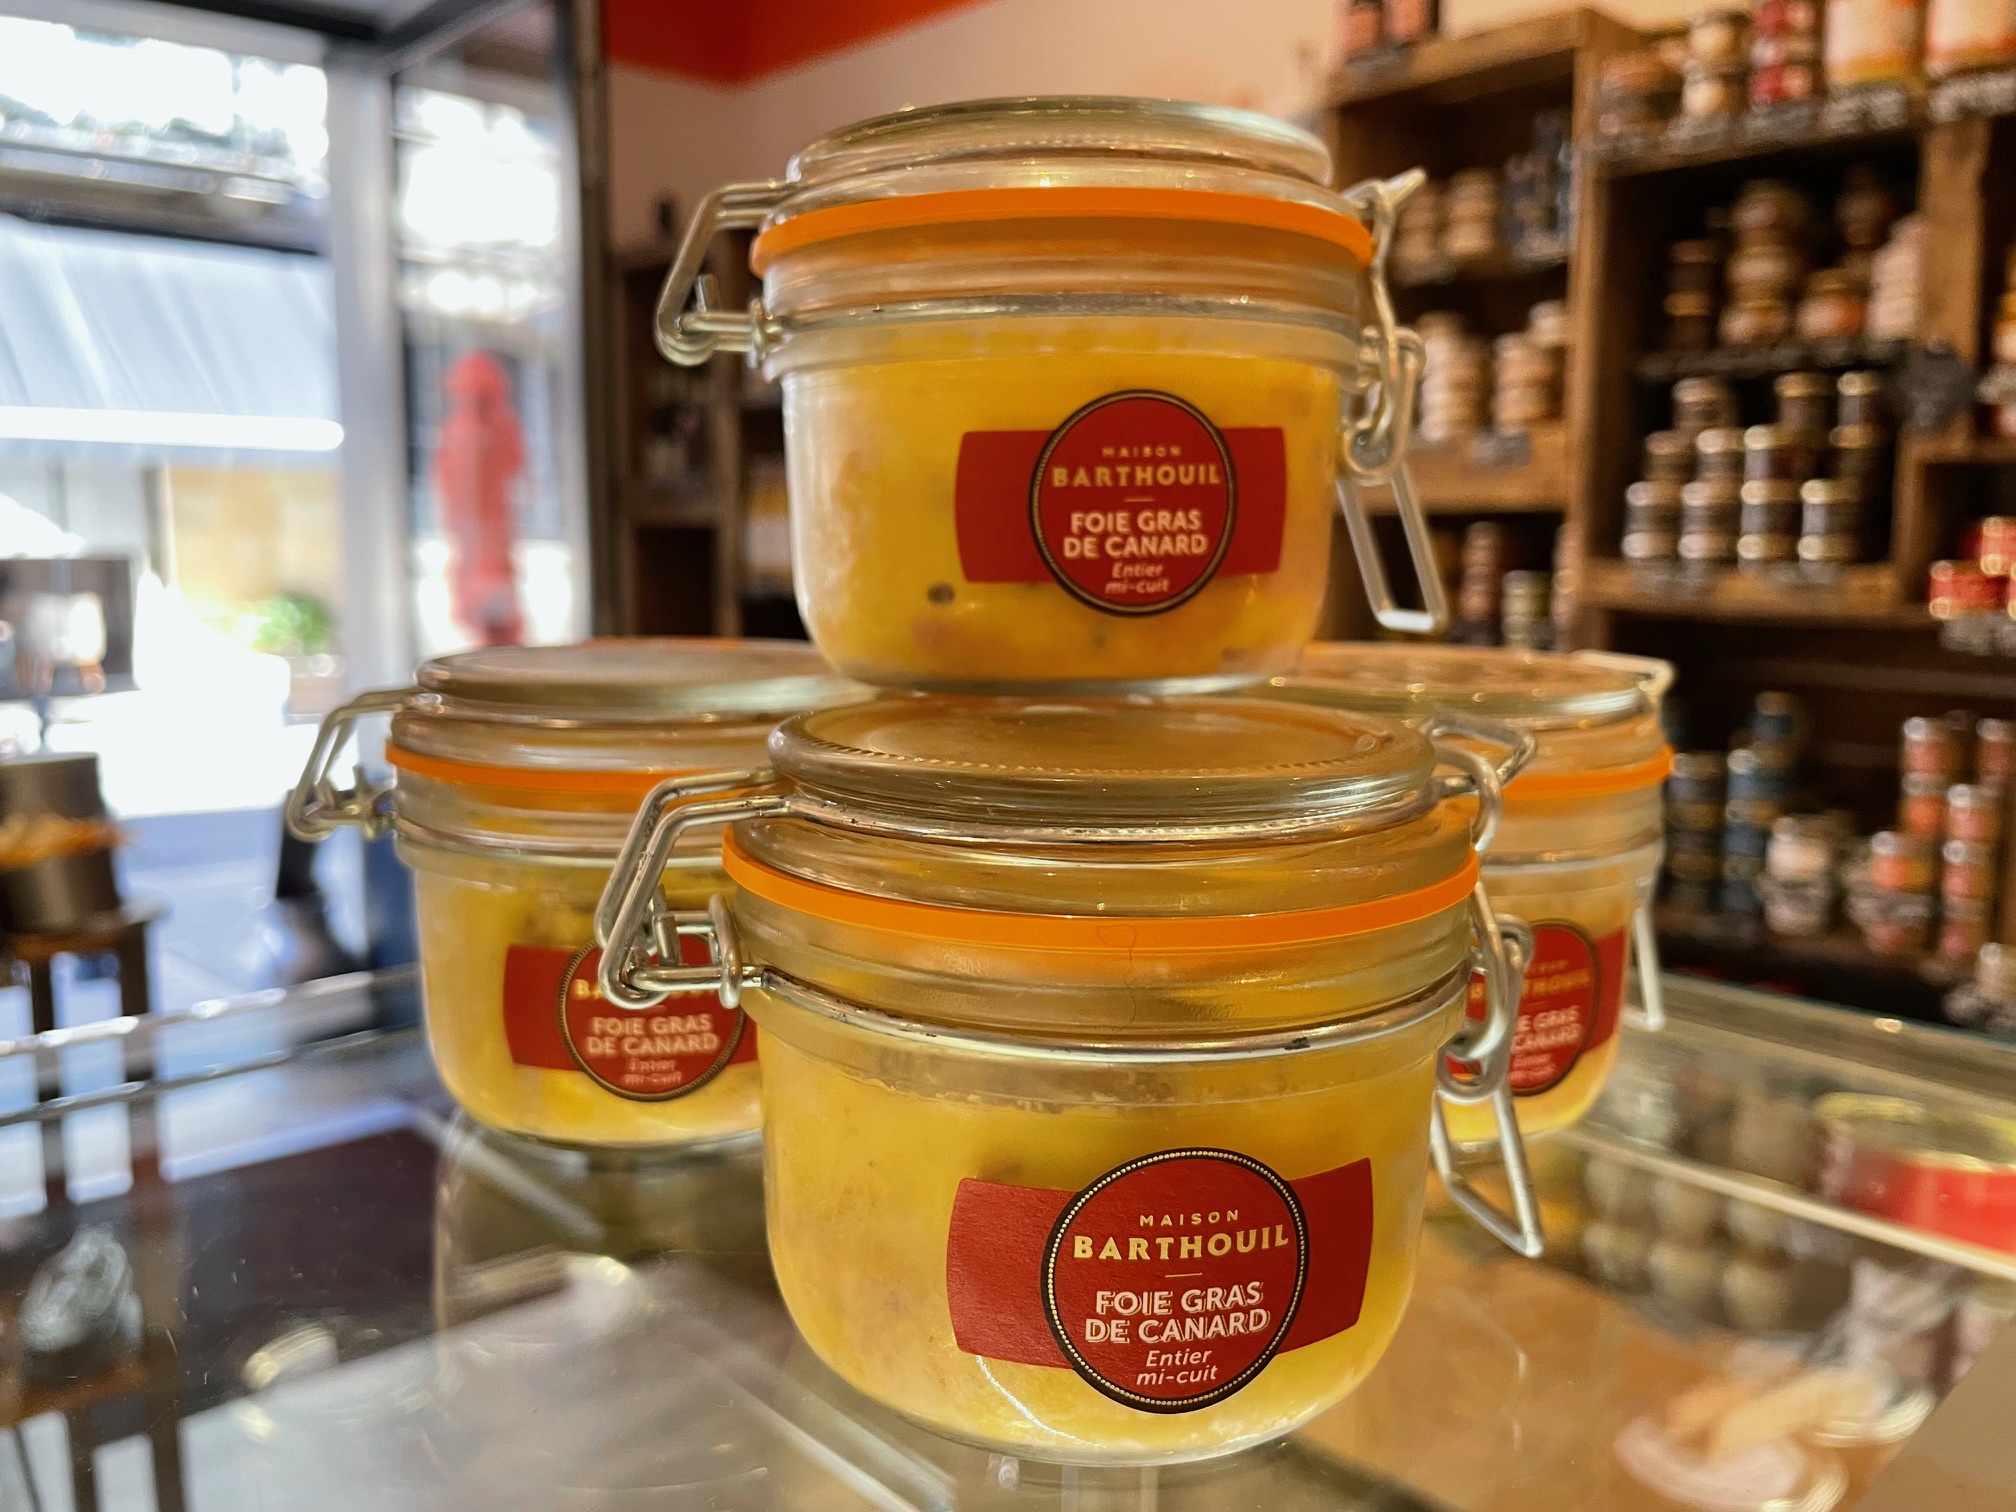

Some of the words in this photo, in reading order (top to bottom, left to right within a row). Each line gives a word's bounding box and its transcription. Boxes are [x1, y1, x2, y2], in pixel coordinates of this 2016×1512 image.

[1102, 444, 1182, 458] MAISON
[1052, 463, 1221, 488] BARTHOUIL
[1070, 511, 1131, 534] FOIE
[1136, 508, 1202, 532] GRAS
[1063, 537, 1100, 559] DE
[1104, 533, 1208, 558] CANARD
[1111, 562, 1164, 578] Entier
[1104, 578, 1170, 594] mi-cuit
[591, 1016, 646, 1036] FOIE
[651, 1013, 712, 1034] GRAS
[586, 1036, 618, 1056] DE
[621, 1032, 720, 1055] CANARD
[1139, 1209, 1239, 1227] MAISON
[1073, 1224, 1289, 1260] BARTHOUIL
[1095, 1290, 1173, 1316] FOIE
[1181, 1281, 1264, 1312] GRAS
[1085, 1318, 1131, 1344] DE
[1137, 1308, 1270, 1343] CANARD
[1145, 1349, 1212, 1367] Entier
[1136, 1364, 1218, 1386] mi-cuit
